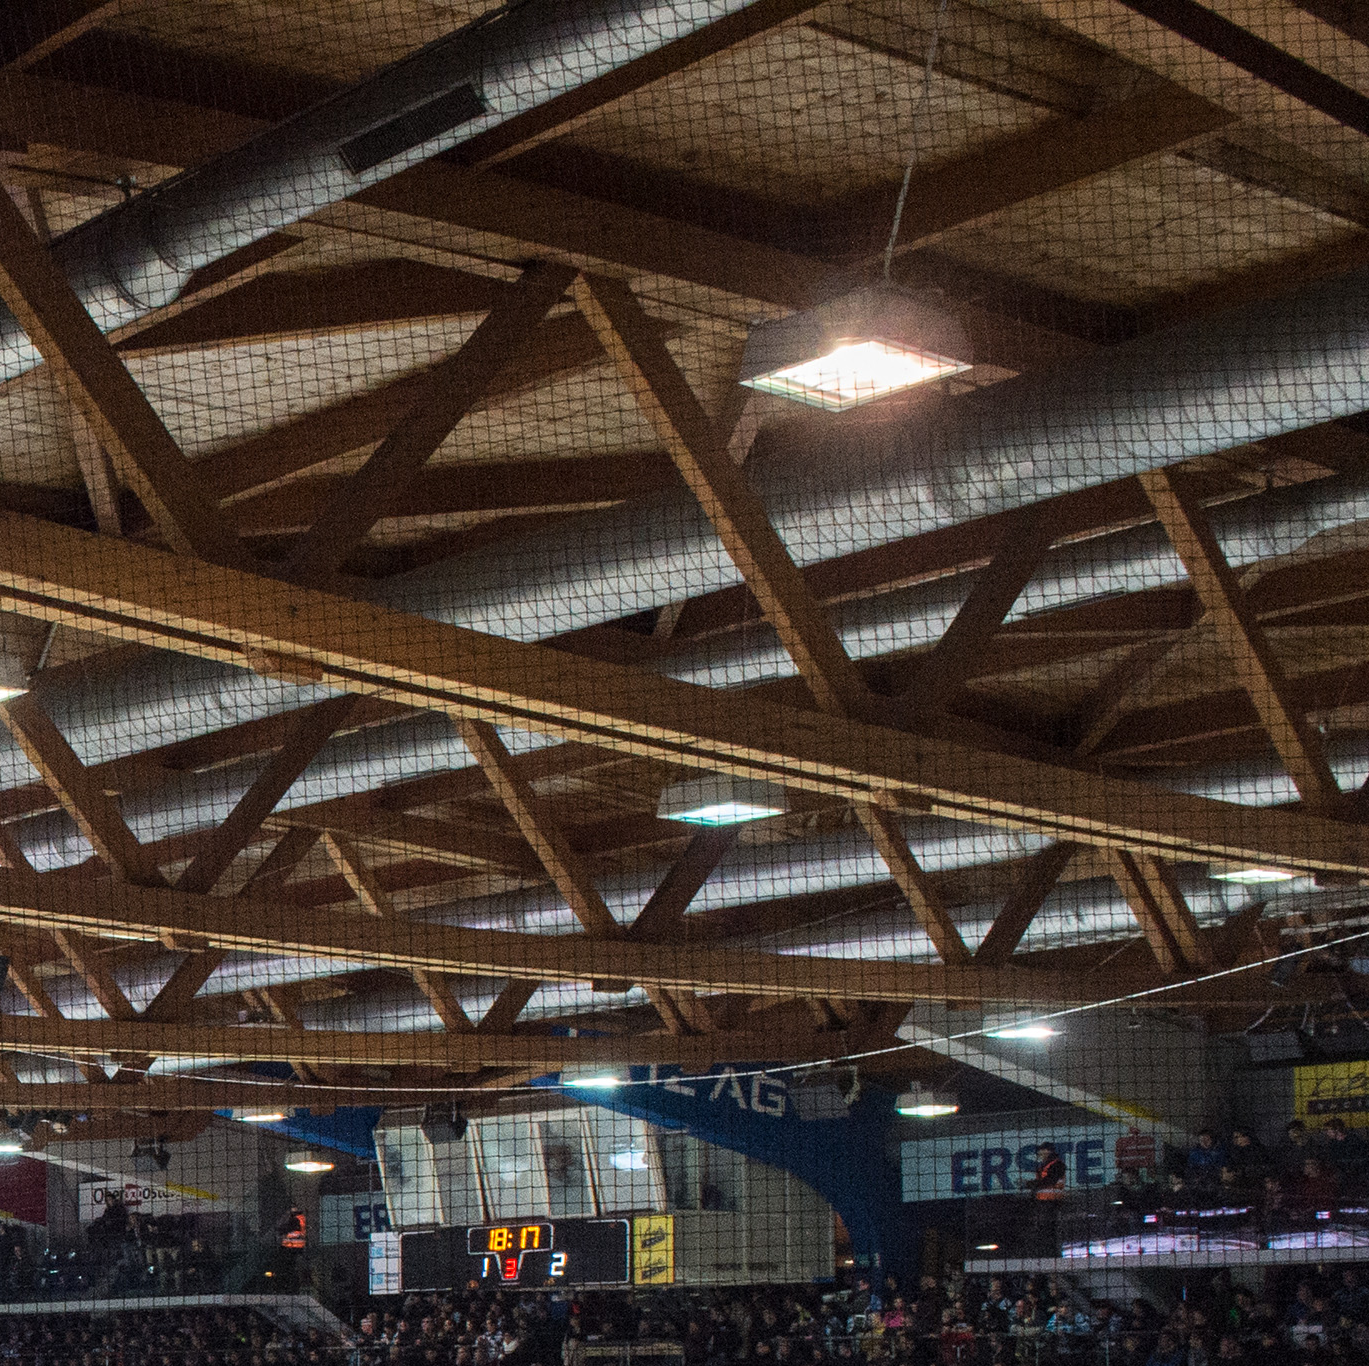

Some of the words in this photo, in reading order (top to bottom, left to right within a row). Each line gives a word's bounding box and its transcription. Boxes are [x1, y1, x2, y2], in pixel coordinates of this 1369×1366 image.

[489, 1226, 540, 1251] 18:17
[482, 1257, 490, 1278] 1
[505, 1258, 517, 1280] 3
[549, 1252, 566, 1276] 2
